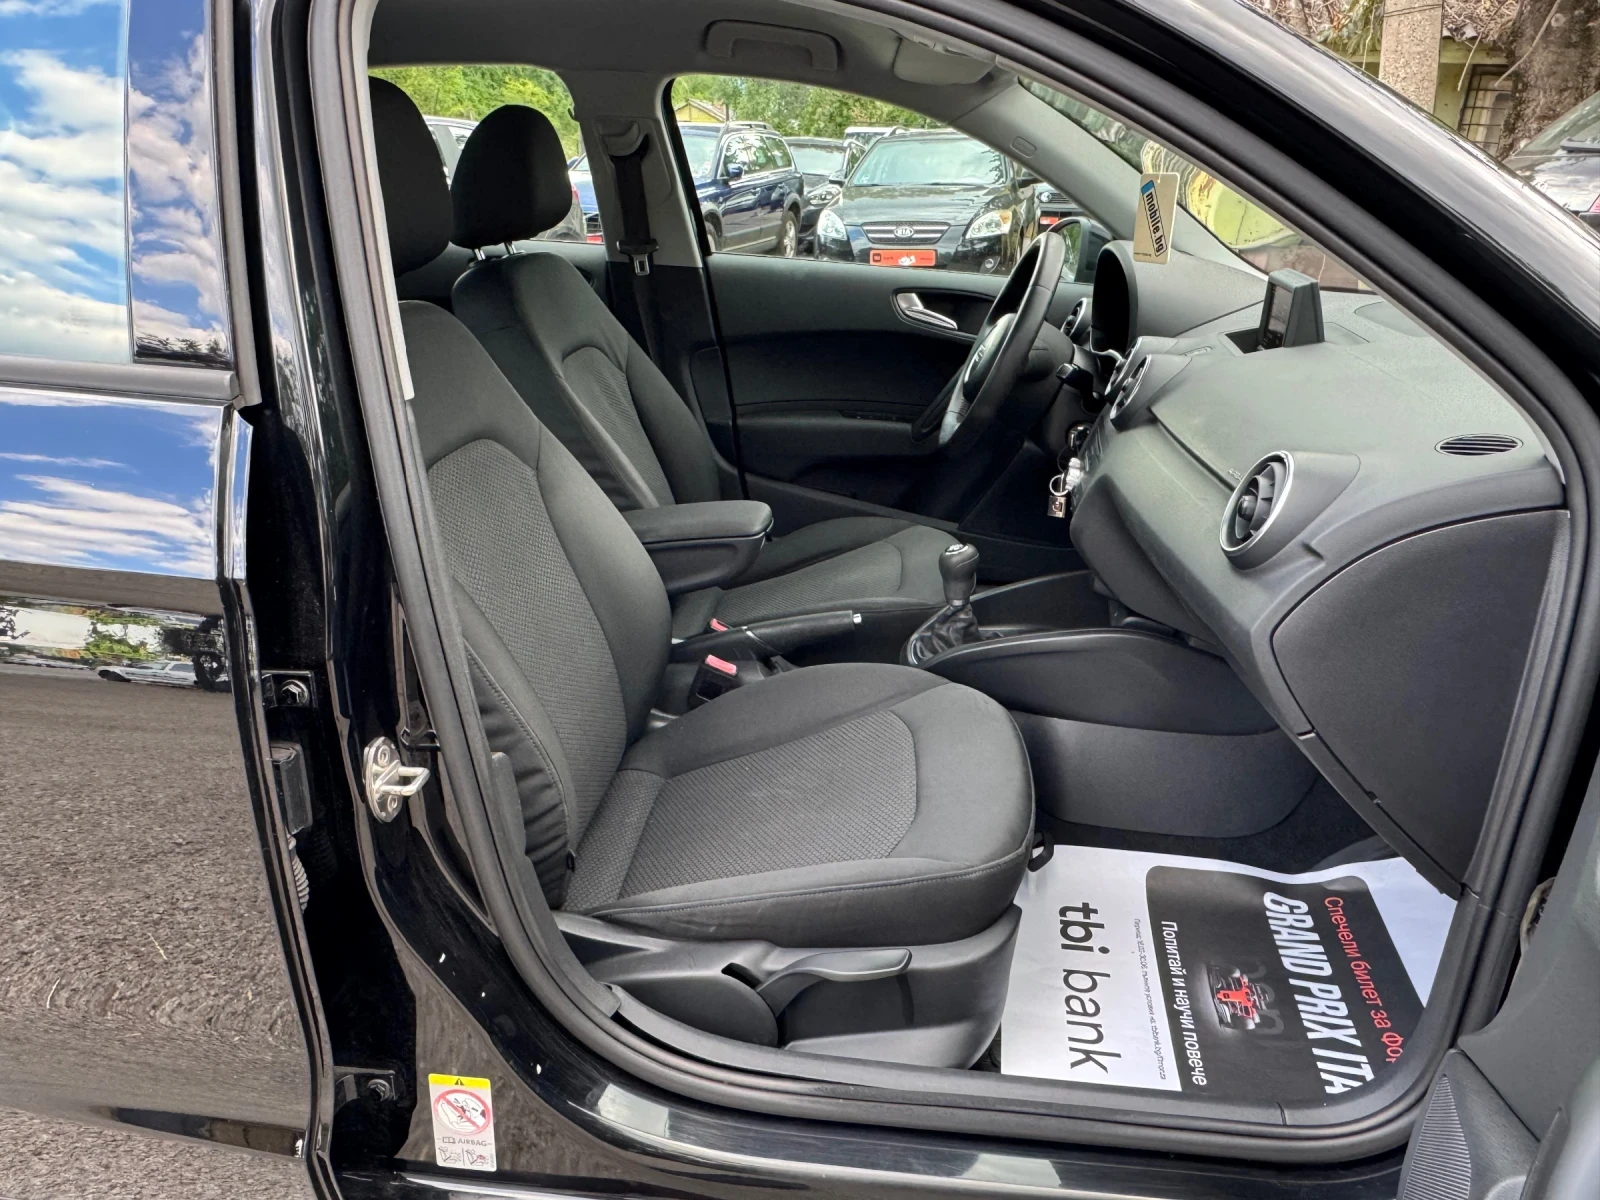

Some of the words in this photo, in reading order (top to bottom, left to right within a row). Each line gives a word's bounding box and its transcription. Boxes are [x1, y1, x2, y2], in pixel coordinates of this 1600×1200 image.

[1146, 192, 1164, 253] mobile.bg
[1058, 902, 1110, 955] tbi
[1161, 921, 1187, 976] Попитай
[1263, 891, 1333, 977] GRAND
[1171, 977, 1186, 987] и
[1324, 896, 1362, 958] Спечели
[1350, 961, 1383, 1007] билет
[1370, 1009, 1392, 1029] за
[1062, 968, 1122, 1074] bank
[1173, 989, 1195, 1029] научи
[1288, 978, 1362, 1047] PRIX
[1183, 1031, 1207, 1086] повече
[458, 1138, 487, 1147] AIRBAG
